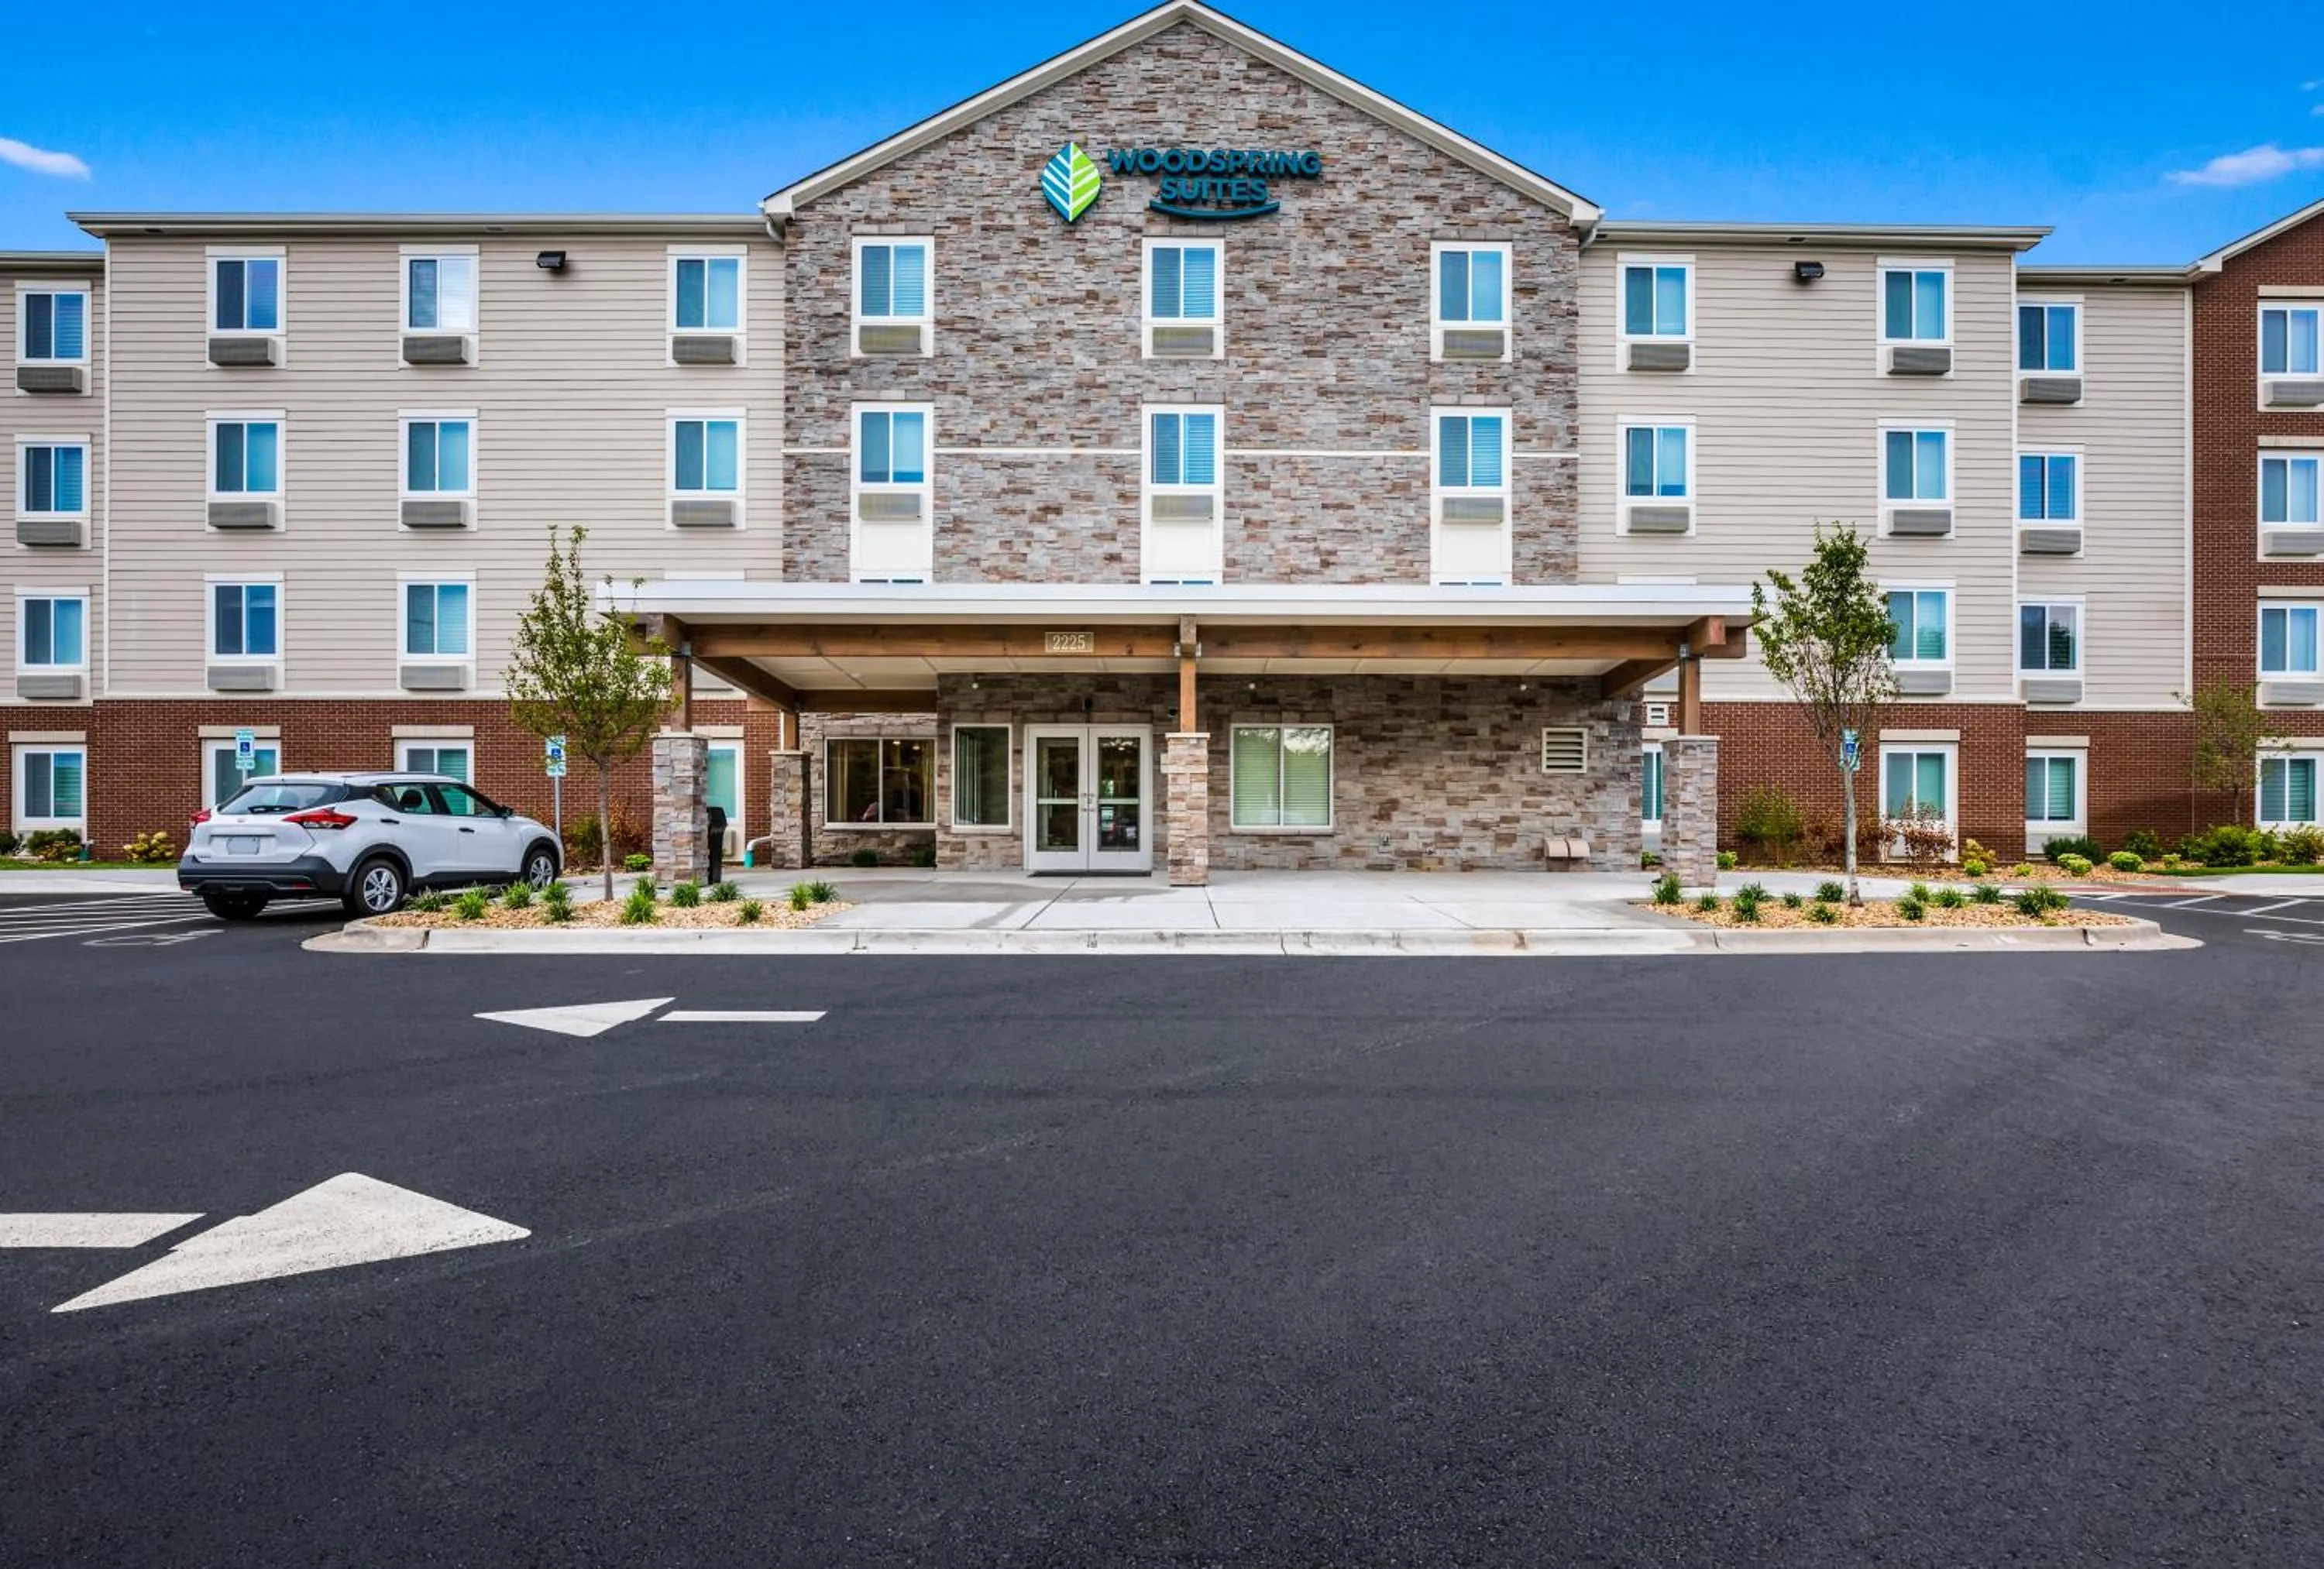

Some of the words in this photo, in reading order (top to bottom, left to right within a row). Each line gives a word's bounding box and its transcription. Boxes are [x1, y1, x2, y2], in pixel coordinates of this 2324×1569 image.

[1108, 148, 1322, 177] WOODSPRING
[1161, 177, 1269, 203] SUITES
[1053, 634, 1085, 651] 2225
